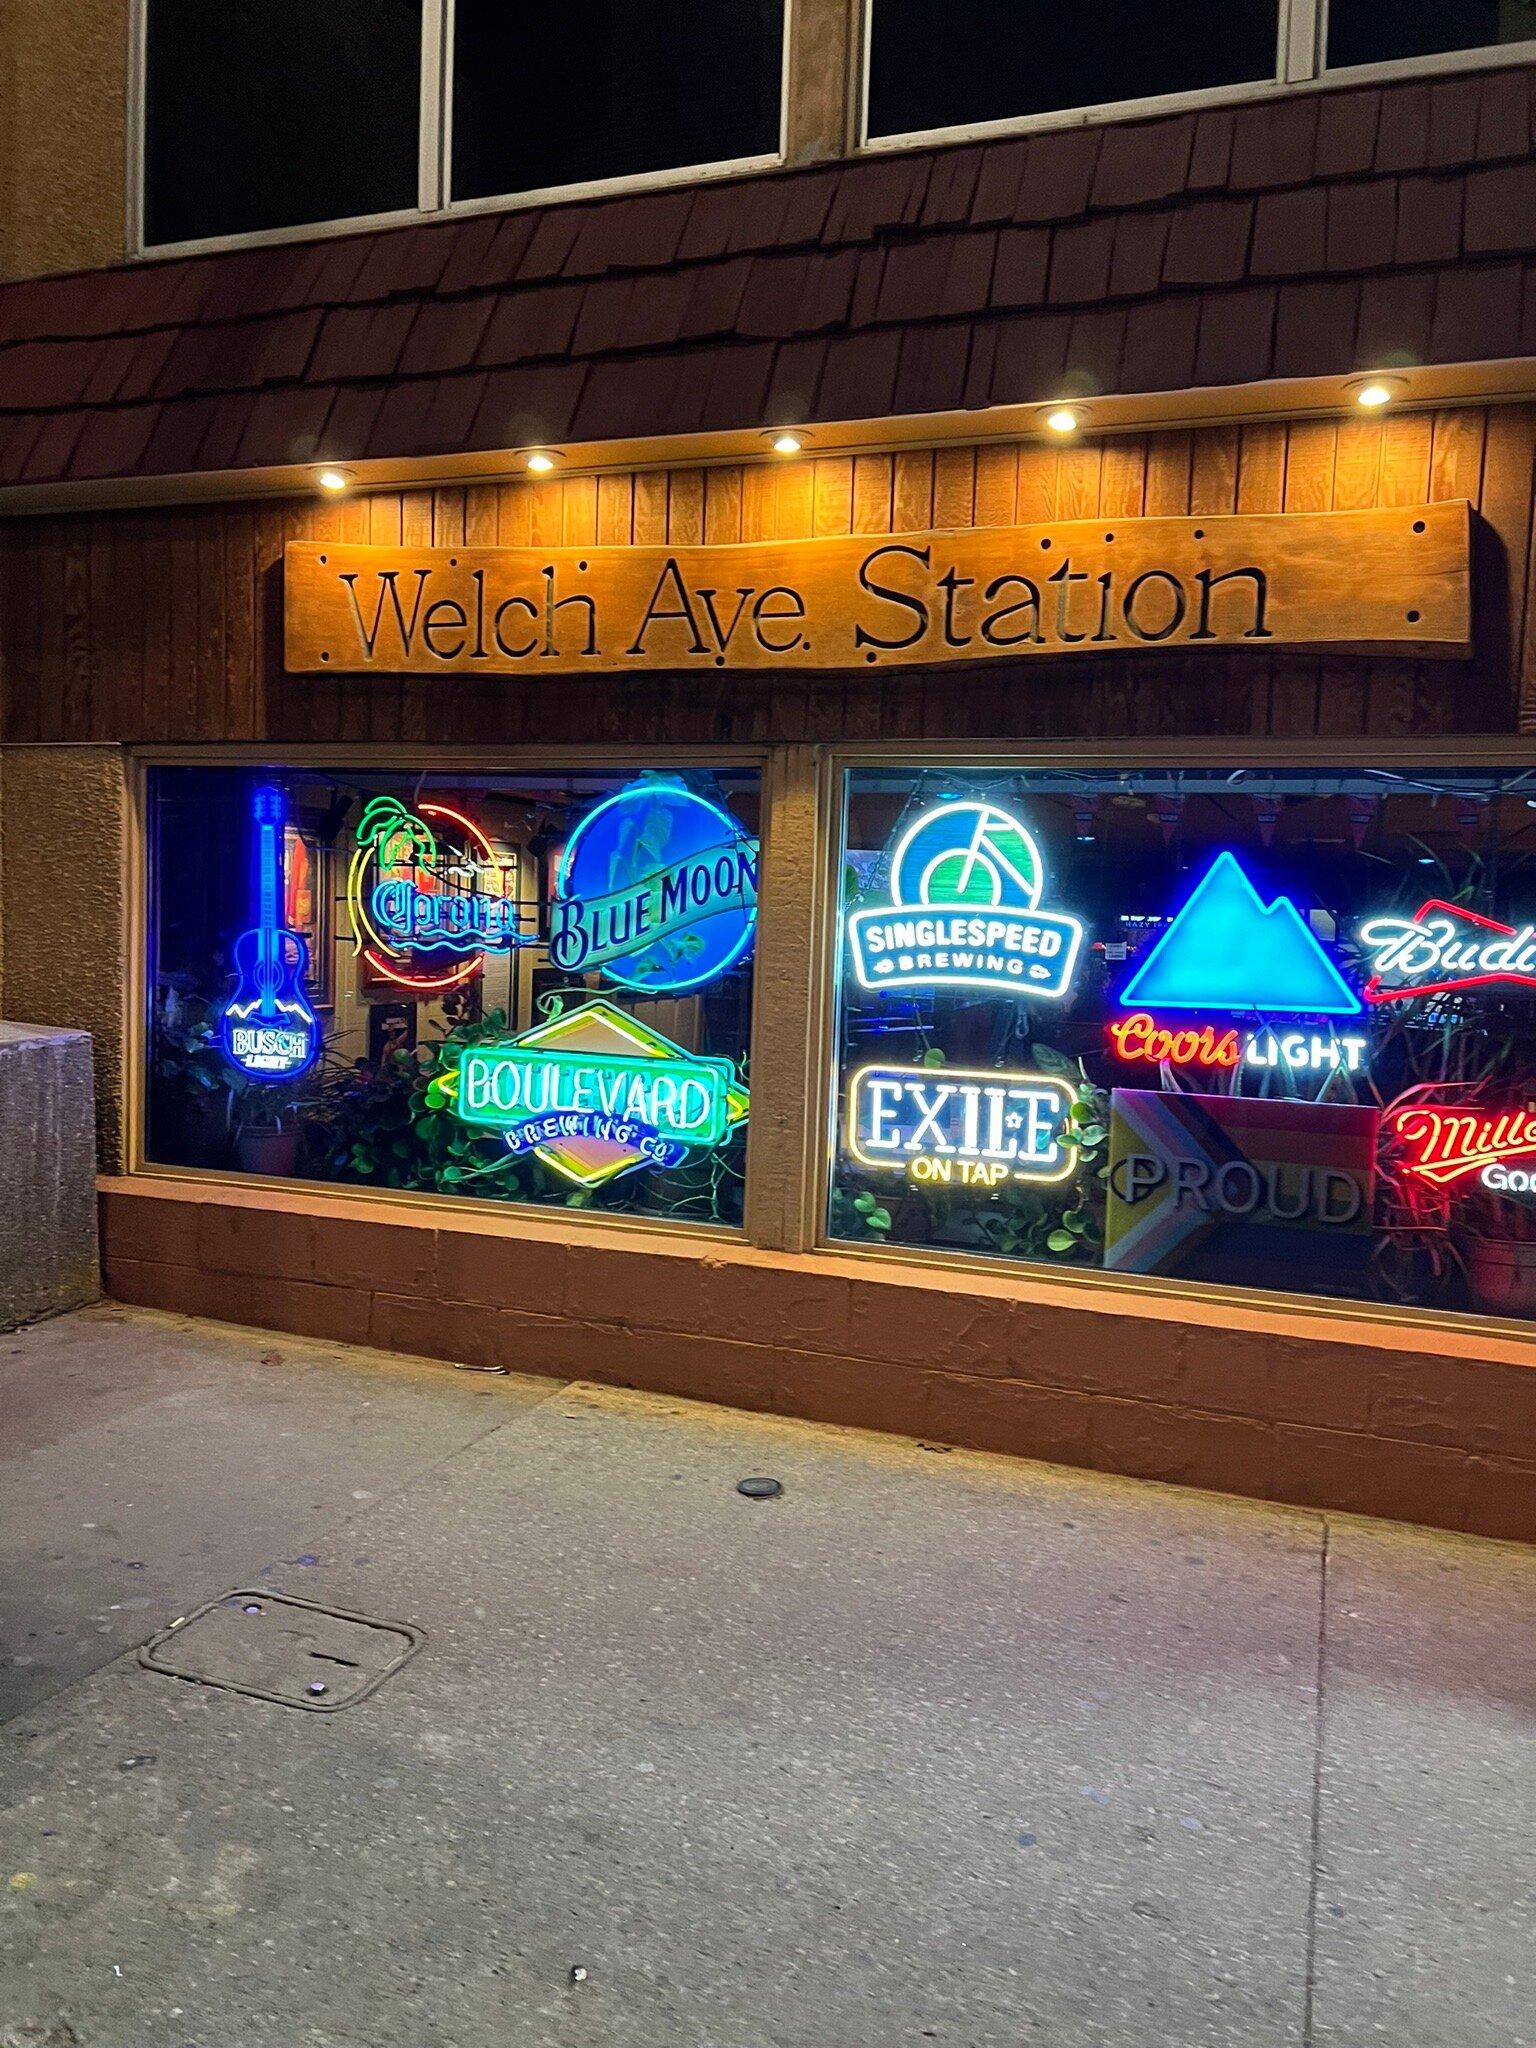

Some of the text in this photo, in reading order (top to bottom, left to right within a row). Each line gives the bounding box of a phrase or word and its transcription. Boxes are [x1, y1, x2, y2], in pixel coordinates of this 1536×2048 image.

[340, 544, 1272, 660] Welch Ave. Station
[372, 880, 516, 934] Corona
[551, 852, 758, 971] BLUE MOON
[866, 918, 1062, 957] SINGLESPEED
[899, 953, 1024, 975] BREWING
[232, 1029, 307, 1059] BUSCH
[1111, 1013, 1366, 1070] Coors LIGHT
[468, 1059, 710, 1129] BOULEVARD
[866, 1081, 1060, 1163] EXILE
[911, 1155, 1009, 1187] ON TAP
[1124, 1154, 1362, 1223] PROUD
